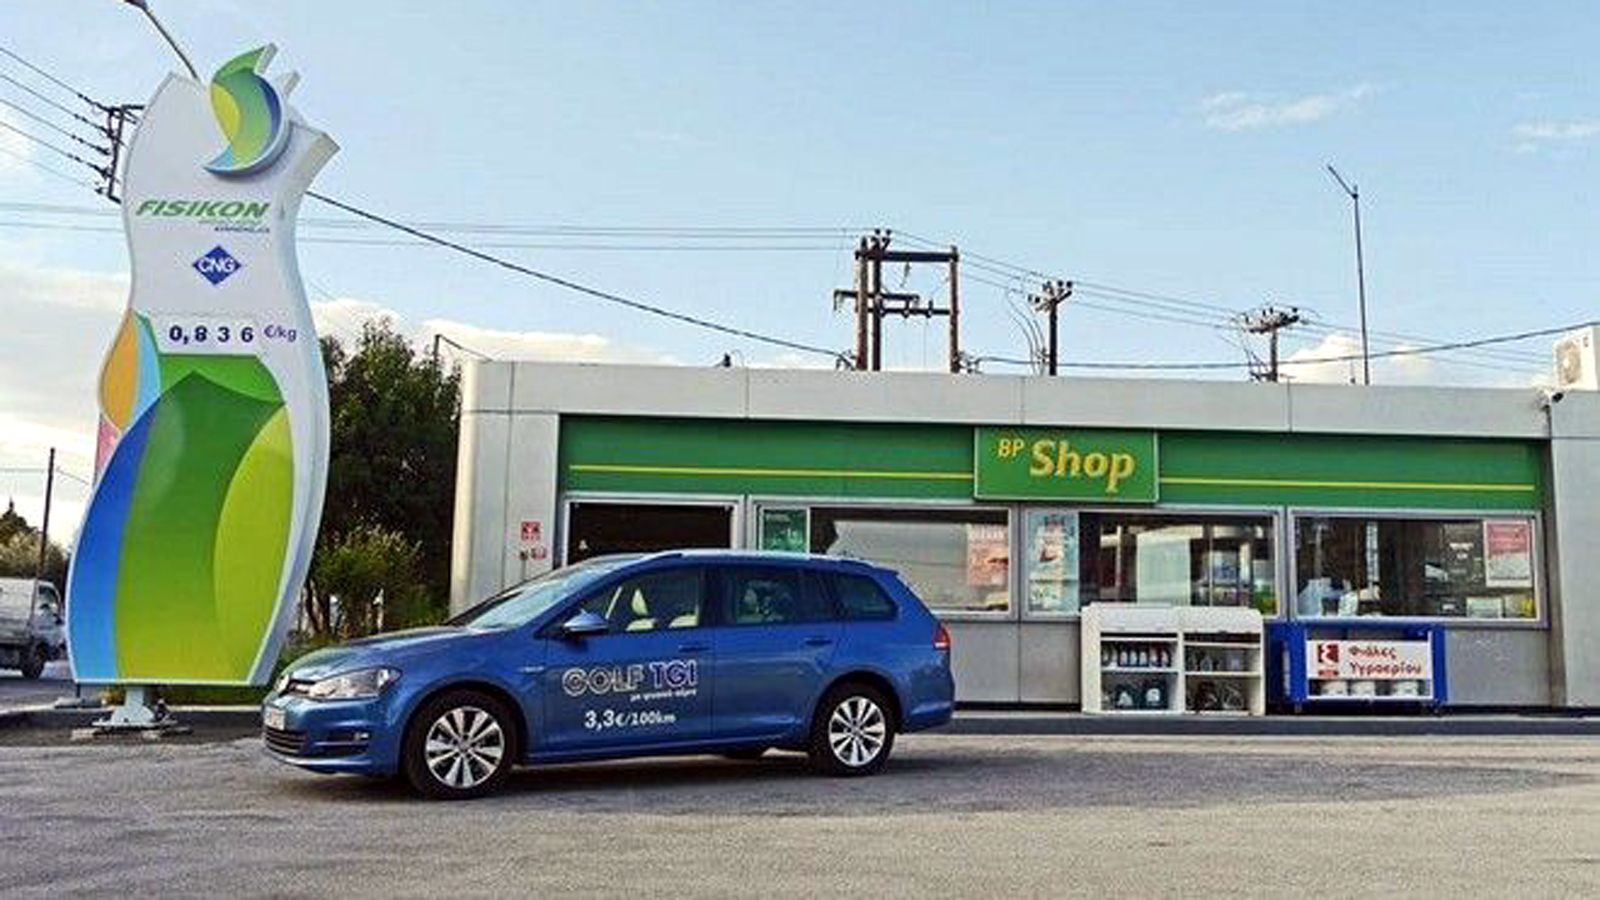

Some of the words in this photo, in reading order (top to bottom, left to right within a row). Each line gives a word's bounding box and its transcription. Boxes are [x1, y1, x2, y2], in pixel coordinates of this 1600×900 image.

[135, 200, 270, 217] FISIKON
[198, 257, 234, 272] CNG
[264, 326, 297, 342] €/kg
[997, 438, 1025, 458] BP
[1030, 439, 1136, 493] Shop
[1349, 646, 1396, 659] Φιάλες
[562, 665, 644, 696] GOLF
[650, 660, 699, 688] TGI
